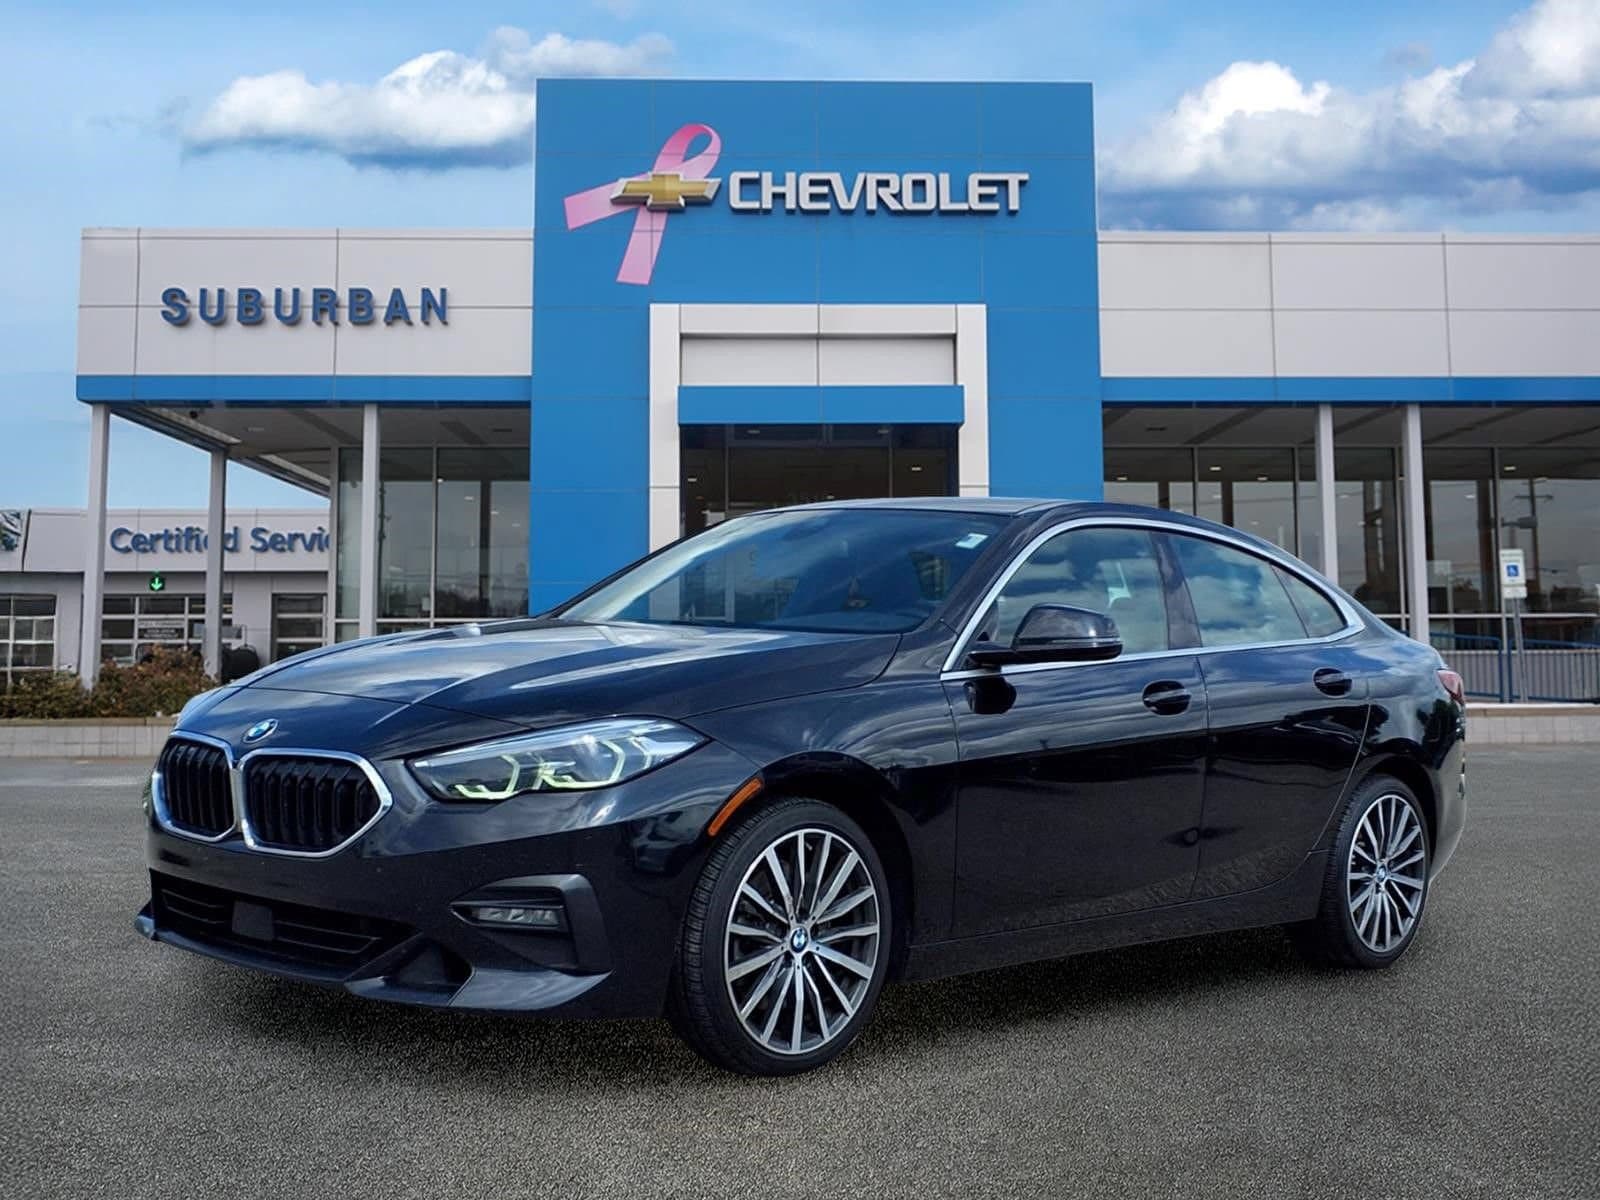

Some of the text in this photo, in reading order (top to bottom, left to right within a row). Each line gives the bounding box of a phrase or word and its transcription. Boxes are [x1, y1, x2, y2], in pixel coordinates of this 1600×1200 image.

[729, 171, 1029, 212] CHEVROLET
[161, 287, 449, 325] SUBURBAN
[250, 526, 330, 553] Servi
